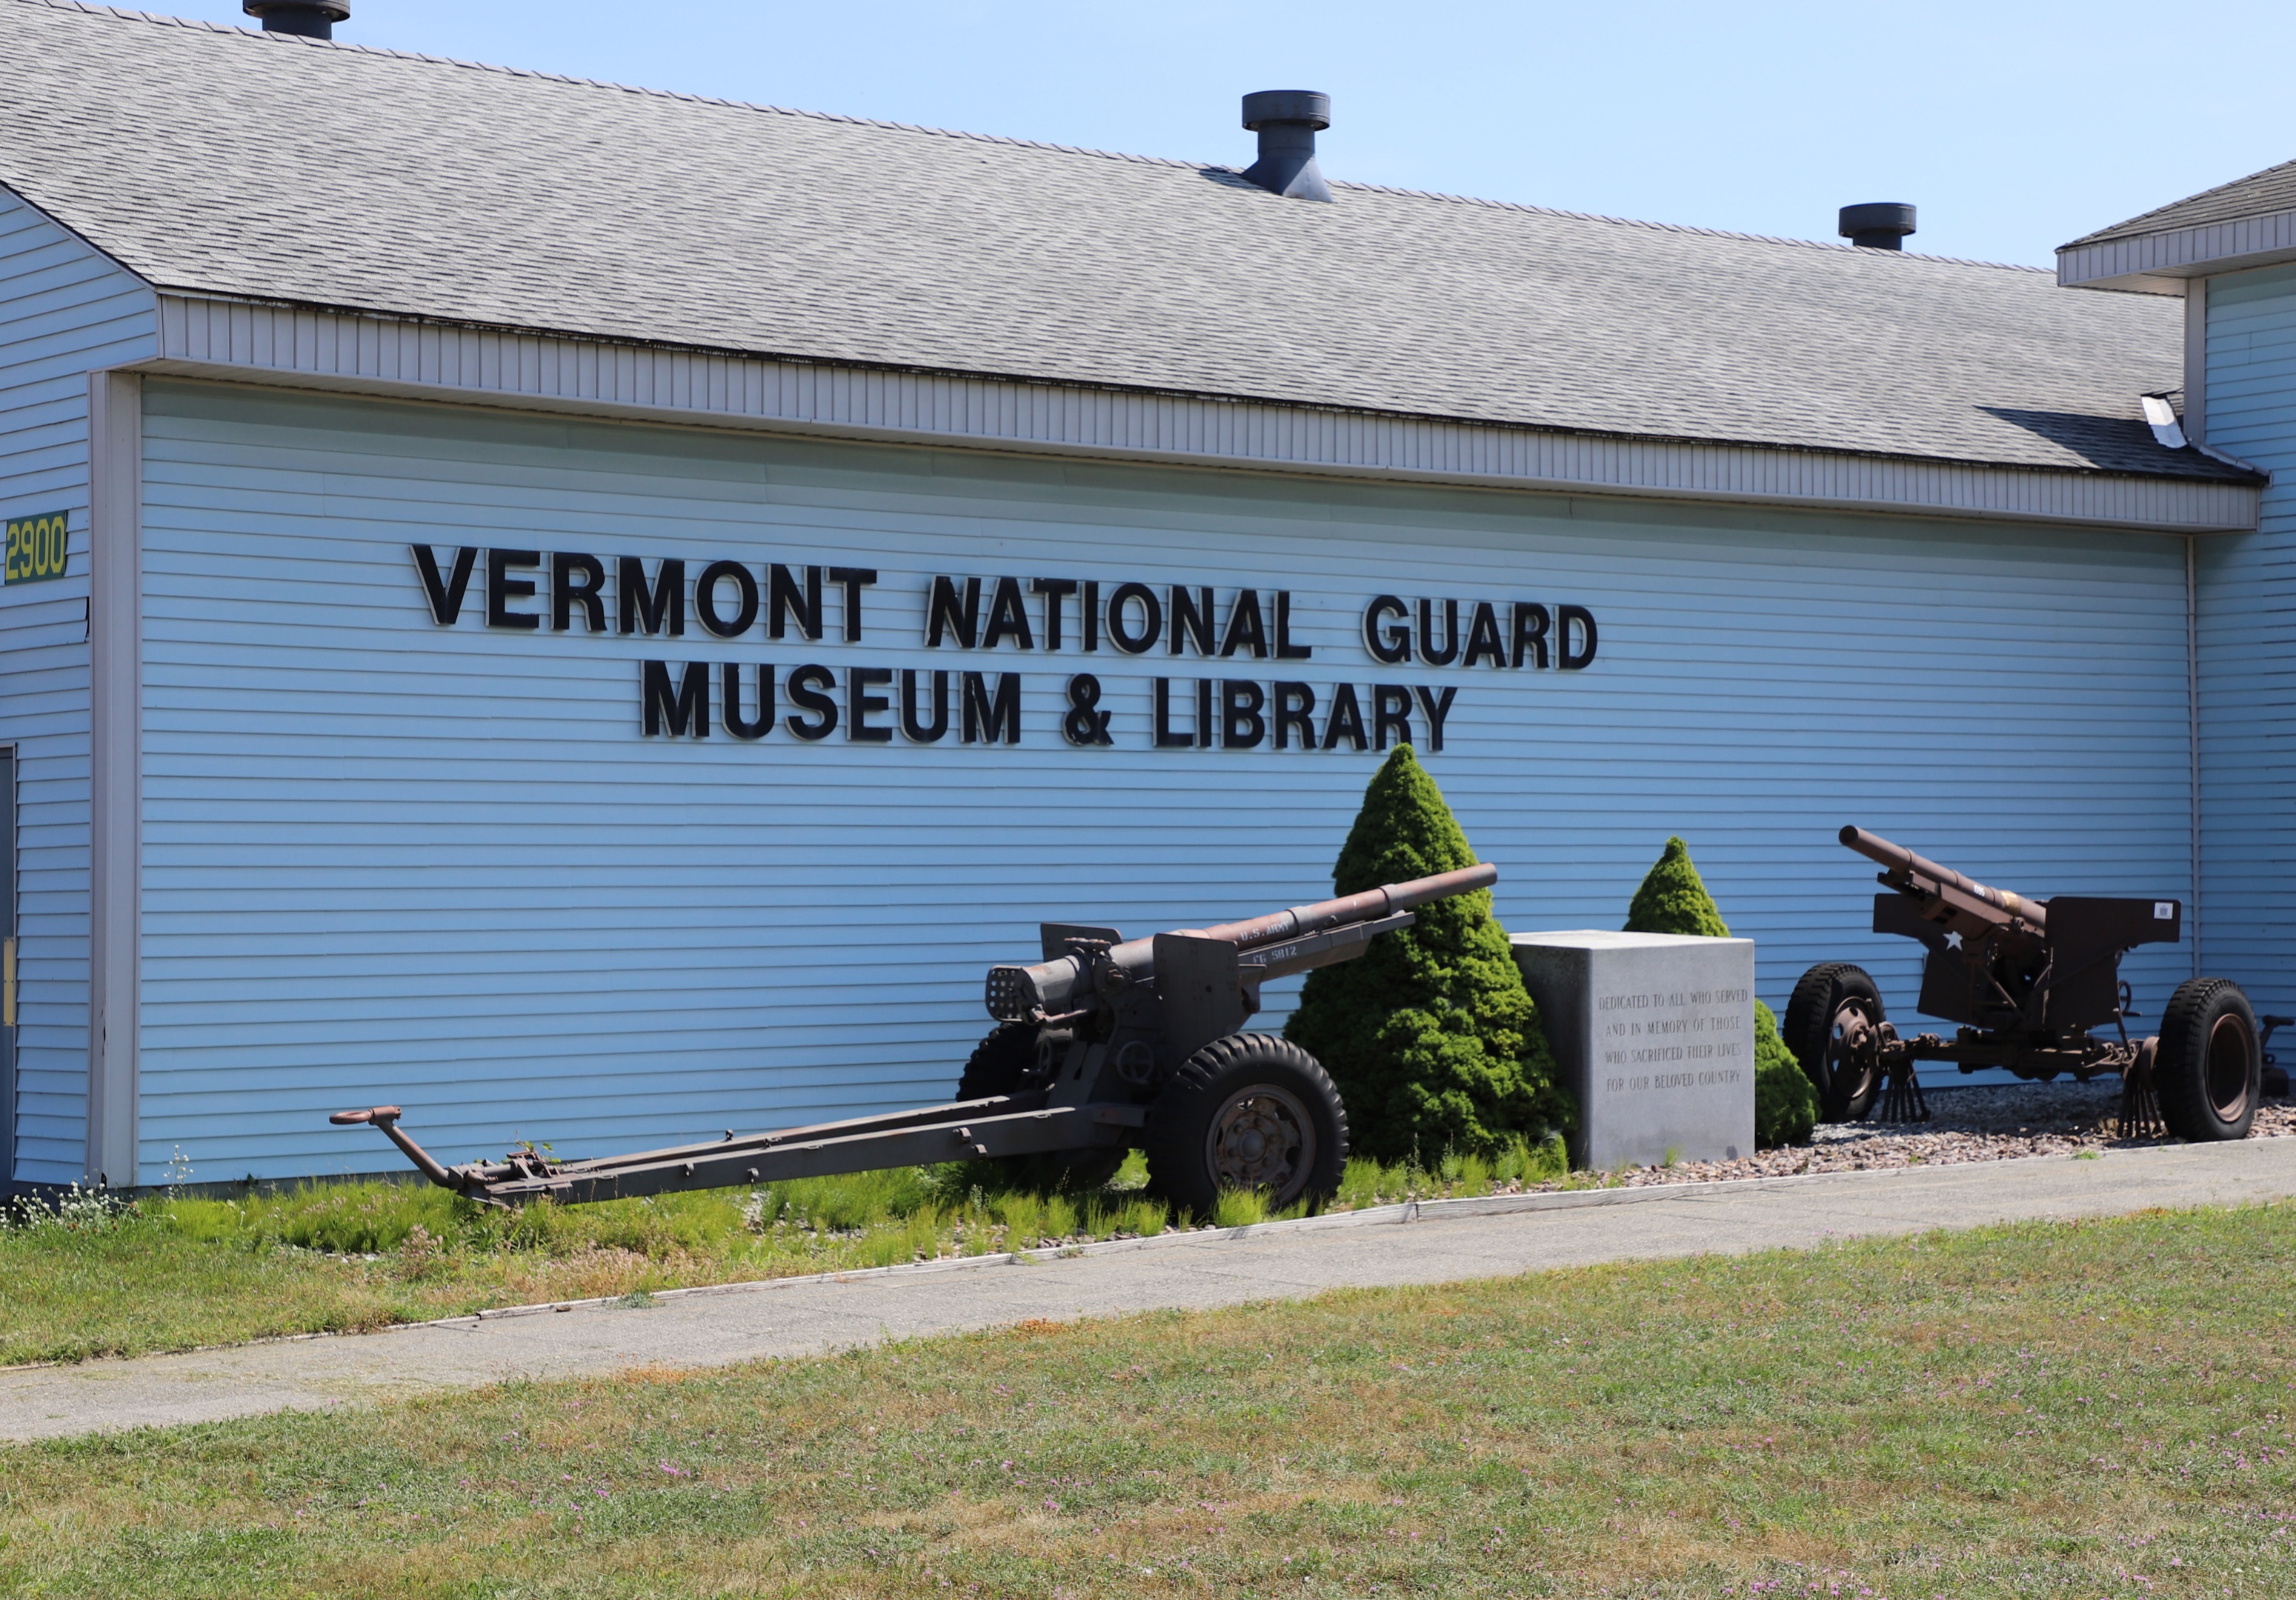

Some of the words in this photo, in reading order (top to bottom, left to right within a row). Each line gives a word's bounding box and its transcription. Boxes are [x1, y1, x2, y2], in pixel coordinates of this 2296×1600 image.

[6, 516, 64, 580] 2900
[410, 544, 878, 642] VERMONT
[924, 575, 1311, 659] NATIONAL
[1362, 595, 1598, 670] GUARD
[640, 660, 1021, 744] MUSEUM
[1062, 673, 1115, 746] &
[1152, 677, 1458, 753] LIBRARY
[1271, 946, 1297, 961] 5812
[1599, 995, 1648, 1010] DEDICATED
[1653, 994, 1665, 1007] TO
[1669, 993, 1686, 1007] ALL
[1690, 991, 1711, 1004] WHO
[1715, 989, 1748, 1004] SERVED
[1605, 1023, 1625, 1037] AND
[1631, 1022, 1641, 1036] IN
[1647, 1019, 1688, 1035] MEMORY
[1694, 1019, 1705, 1032] OF
[1711, 1016, 1741, 1030] THOSE
[1605, 1050, 1627, 1064] WHO
[1631, 1047, 1683, 1063] SACRIFICED
[1687, 1044, 1713, 1059] THEIR
[1718, 1042, 1742, 1057] LIVES
[1606, 1078, 1625, 1092] FOR
[1629, 1076, 1649, 1090] OUR
[1654, 1073, 1694, 1089] BELOVED
[1699, 1070, 1741, 1086] COUNTRY
